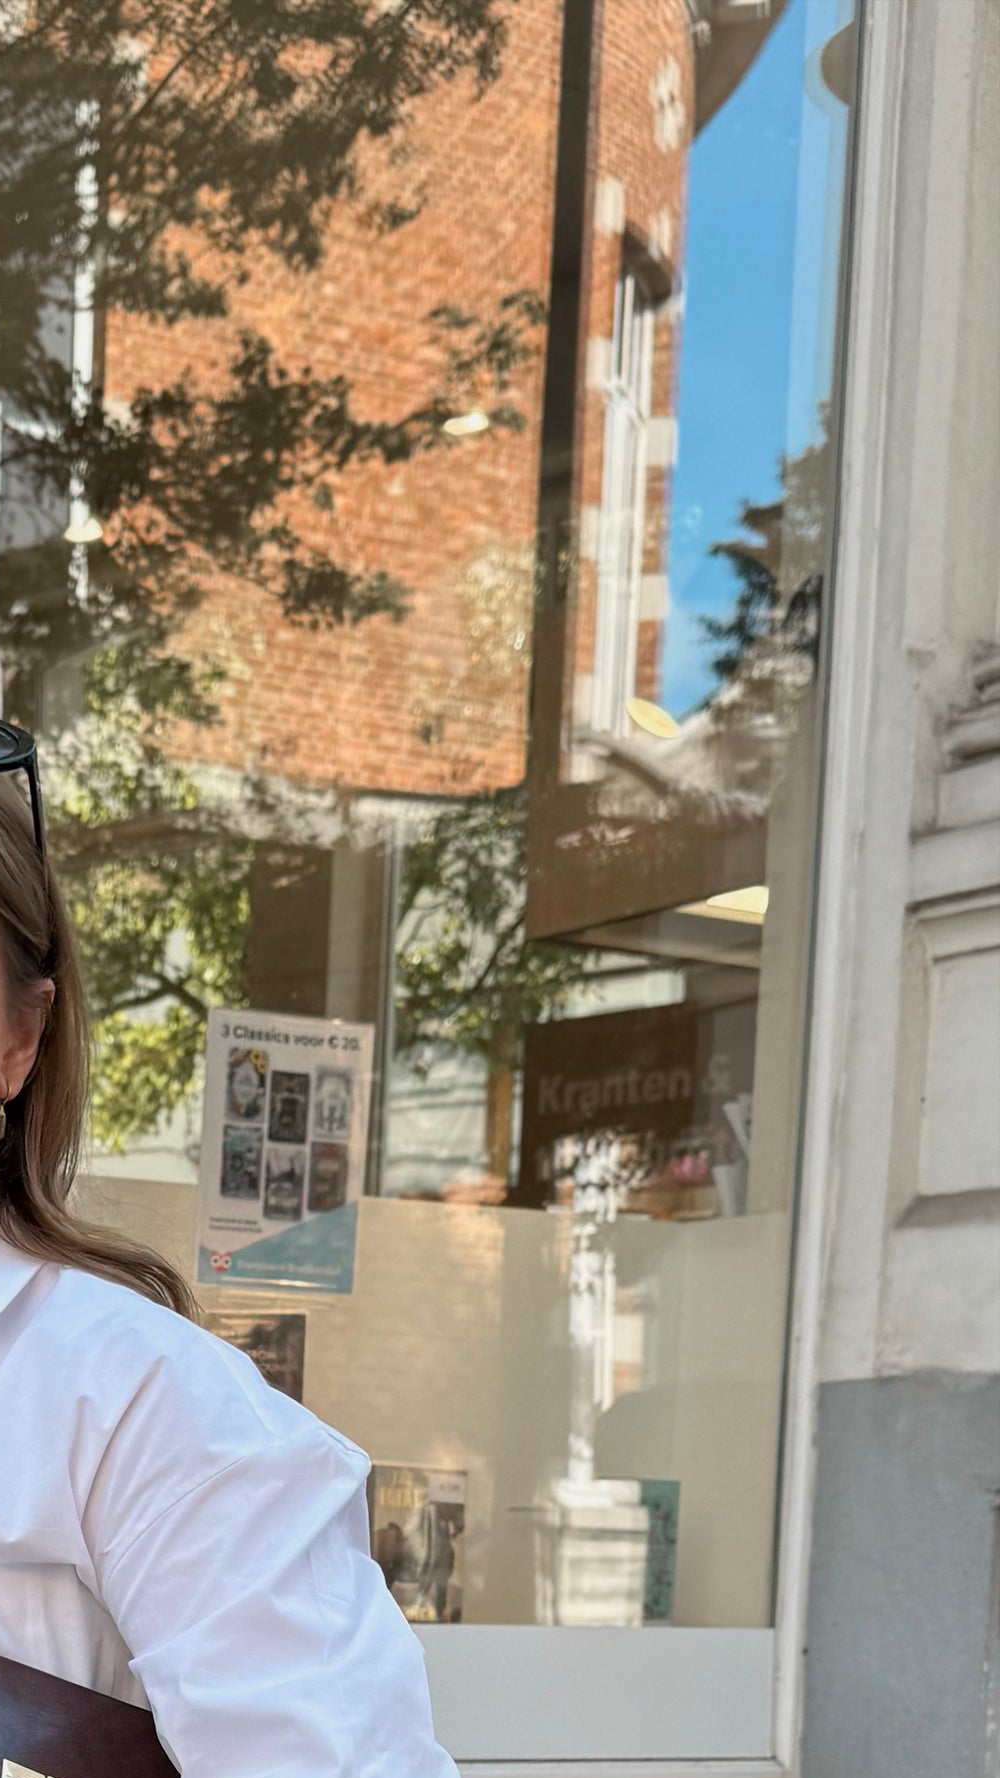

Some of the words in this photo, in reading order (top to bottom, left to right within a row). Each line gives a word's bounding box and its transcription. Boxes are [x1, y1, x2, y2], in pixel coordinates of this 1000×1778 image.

[220, 1023, 230, 1039] 3
[232, 1024, 290, 1044] Classics
[293, 1034, 325, 1047] voor
[327, 1035, 339, 1050] €
[537, 1066, 692, 1116] Kranten
